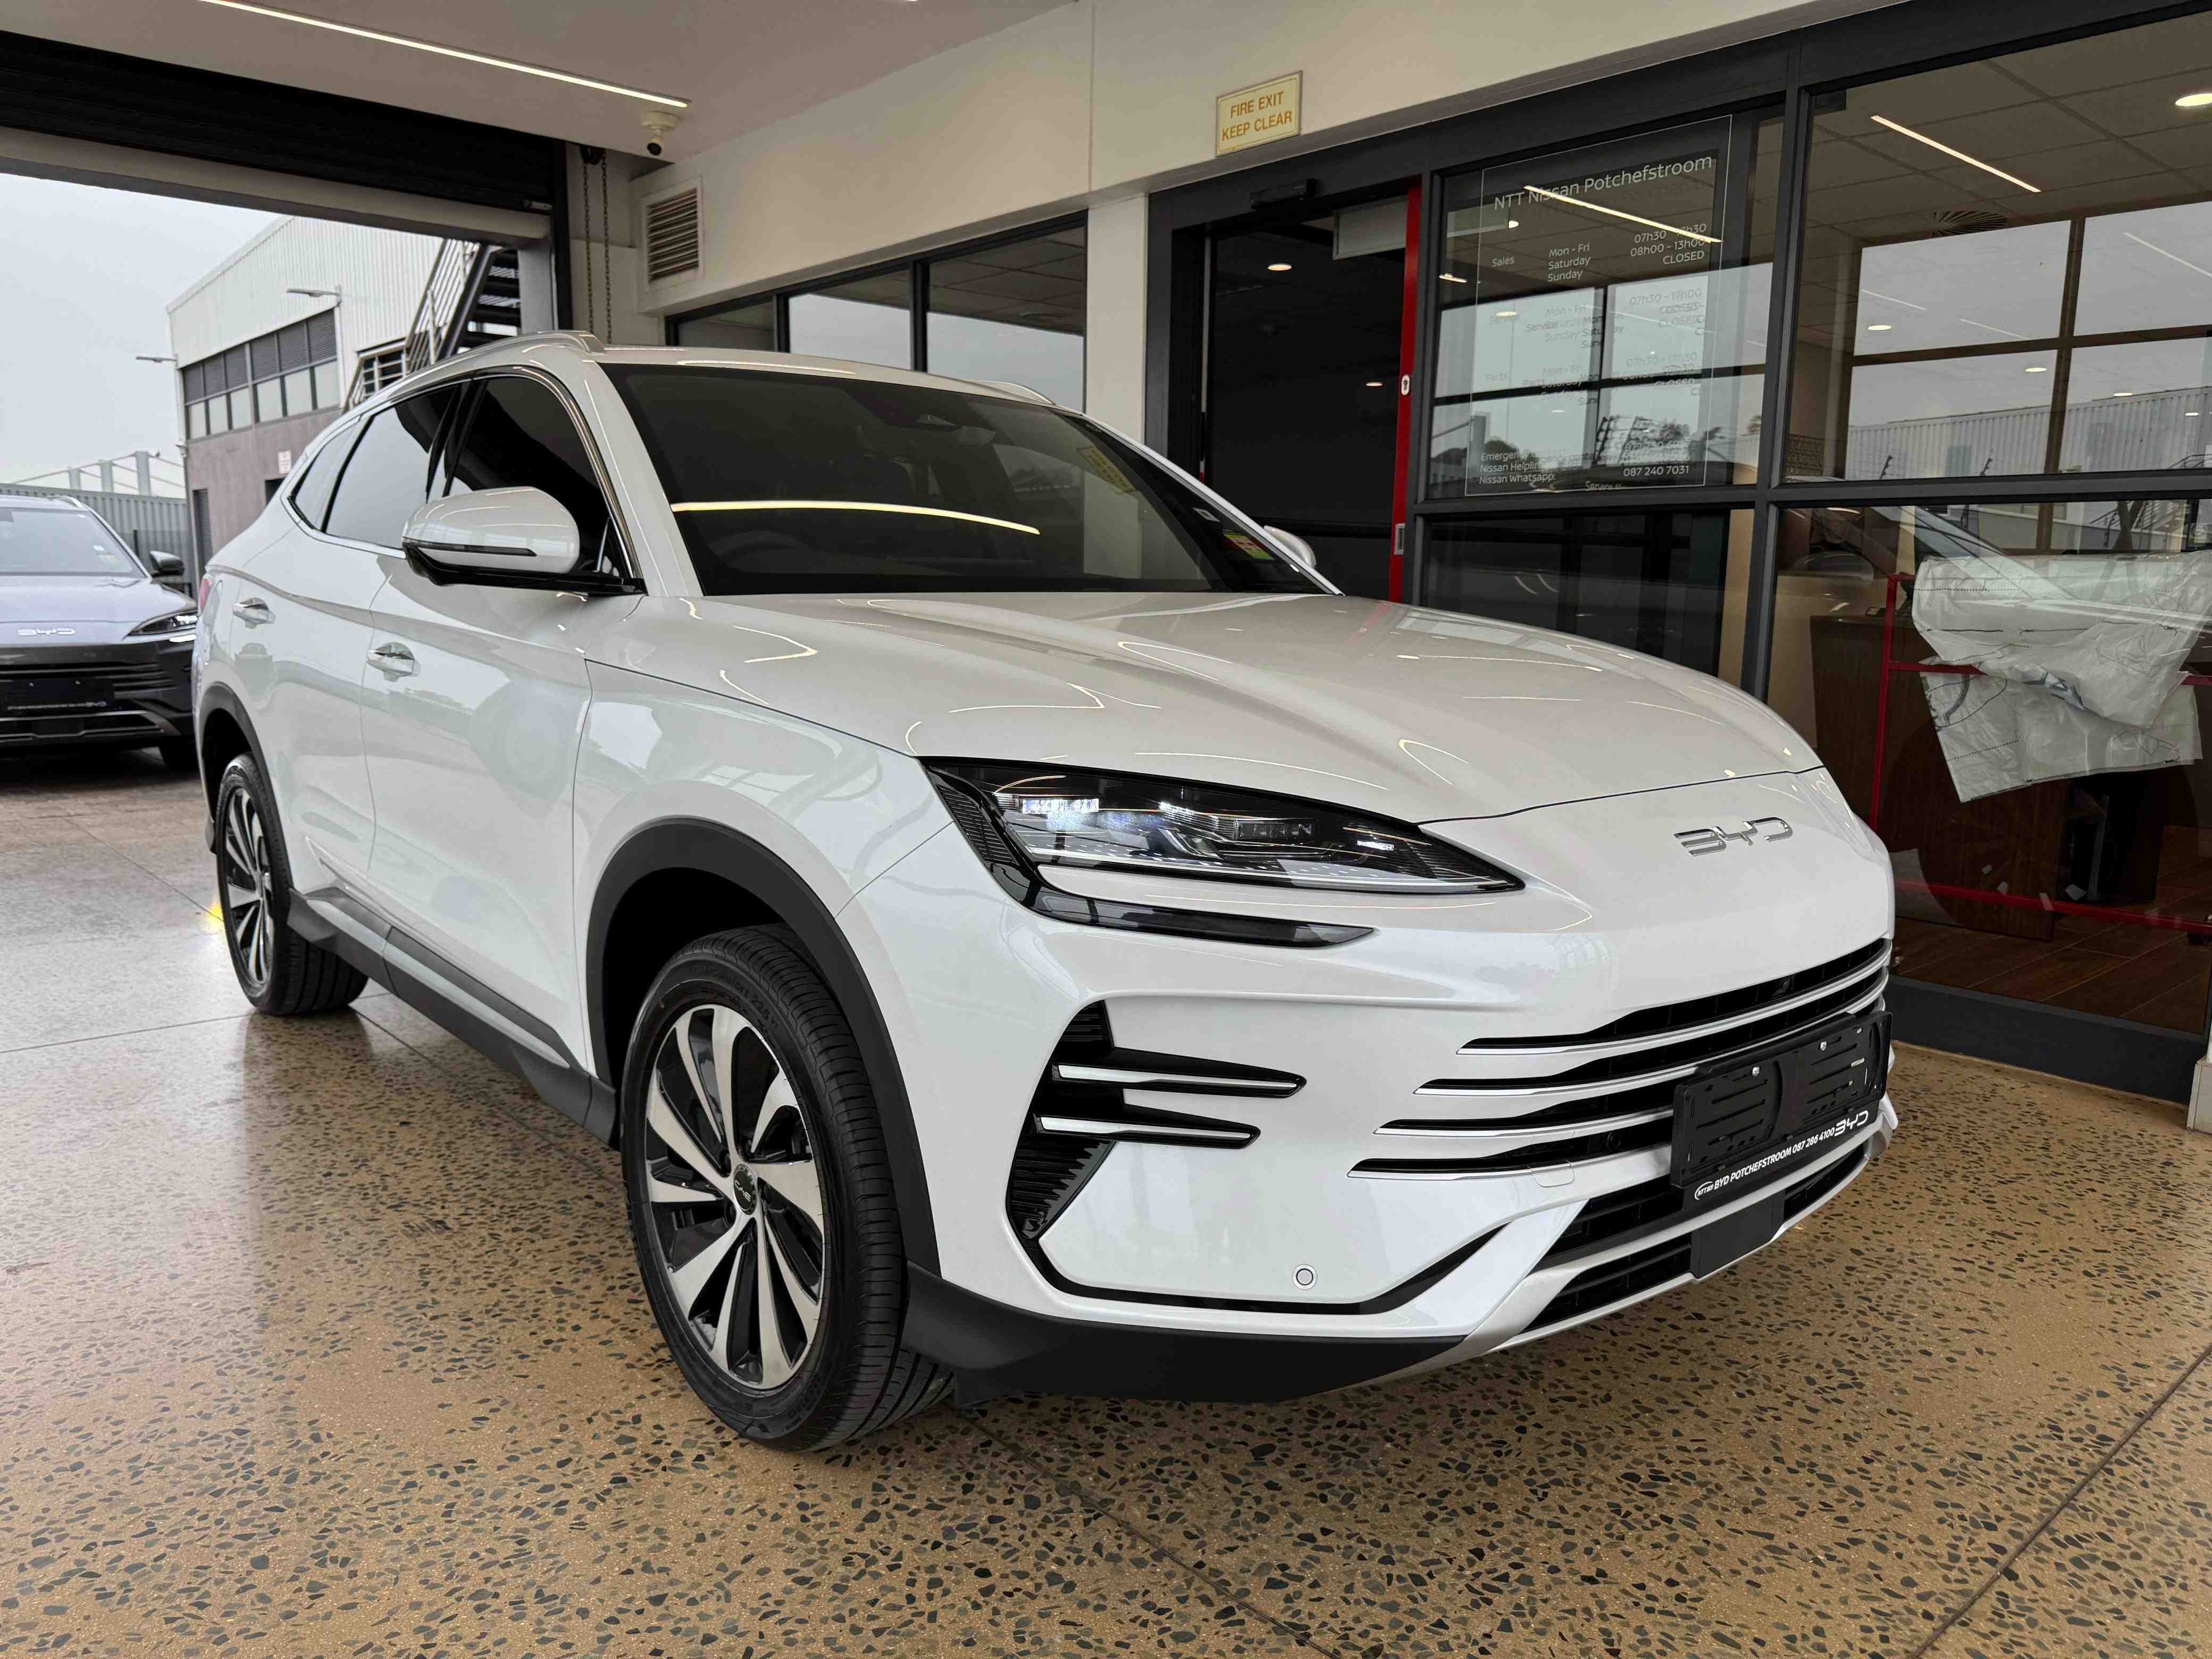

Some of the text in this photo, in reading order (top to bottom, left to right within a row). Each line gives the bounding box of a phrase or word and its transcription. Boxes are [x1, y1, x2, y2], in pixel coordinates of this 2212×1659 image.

[1230, 91, 1284, 119] FIRE EXIT
[1222, 111, 1292, 141] KEEP CLEAR
[1495, 156, 1712, 210] NTT Nissan Potchefstroom
[1634, 230, 1666, 243] 07h30
[1548, 248, 1569, 257] Mon
[1578, 242, 1590, 252] Fri
[1630, 244, 1664, 256] 08h00
[1674, 238, 1705, 250] 13h00
[1492, 256, 1514, 267] Sales
[1548, 256, 1590, 270] Saturday
[1663, 250, 1704, 264] CLOSED
[1548, 270, 1582, 282] Sunday
[1480, 464, 1509, 473] Nissan
[1623, 465, 1689, 477] 087 240 7031
[1479, 476, 1507, 484] Nissan
[1673, 817, 1793, 857] BYD
[1714, 1175, 1730, 1191] BYD
[1730, 1146, 1792, 1183] POTCHEFSTROOM
[1792, 1140, 1806, 1153] 087
[1805, 1134, 1819, 1148] 286
[1819, 1127, 1835, 1141] 4100
[1834, 1110, 1869, 1137] BYD
